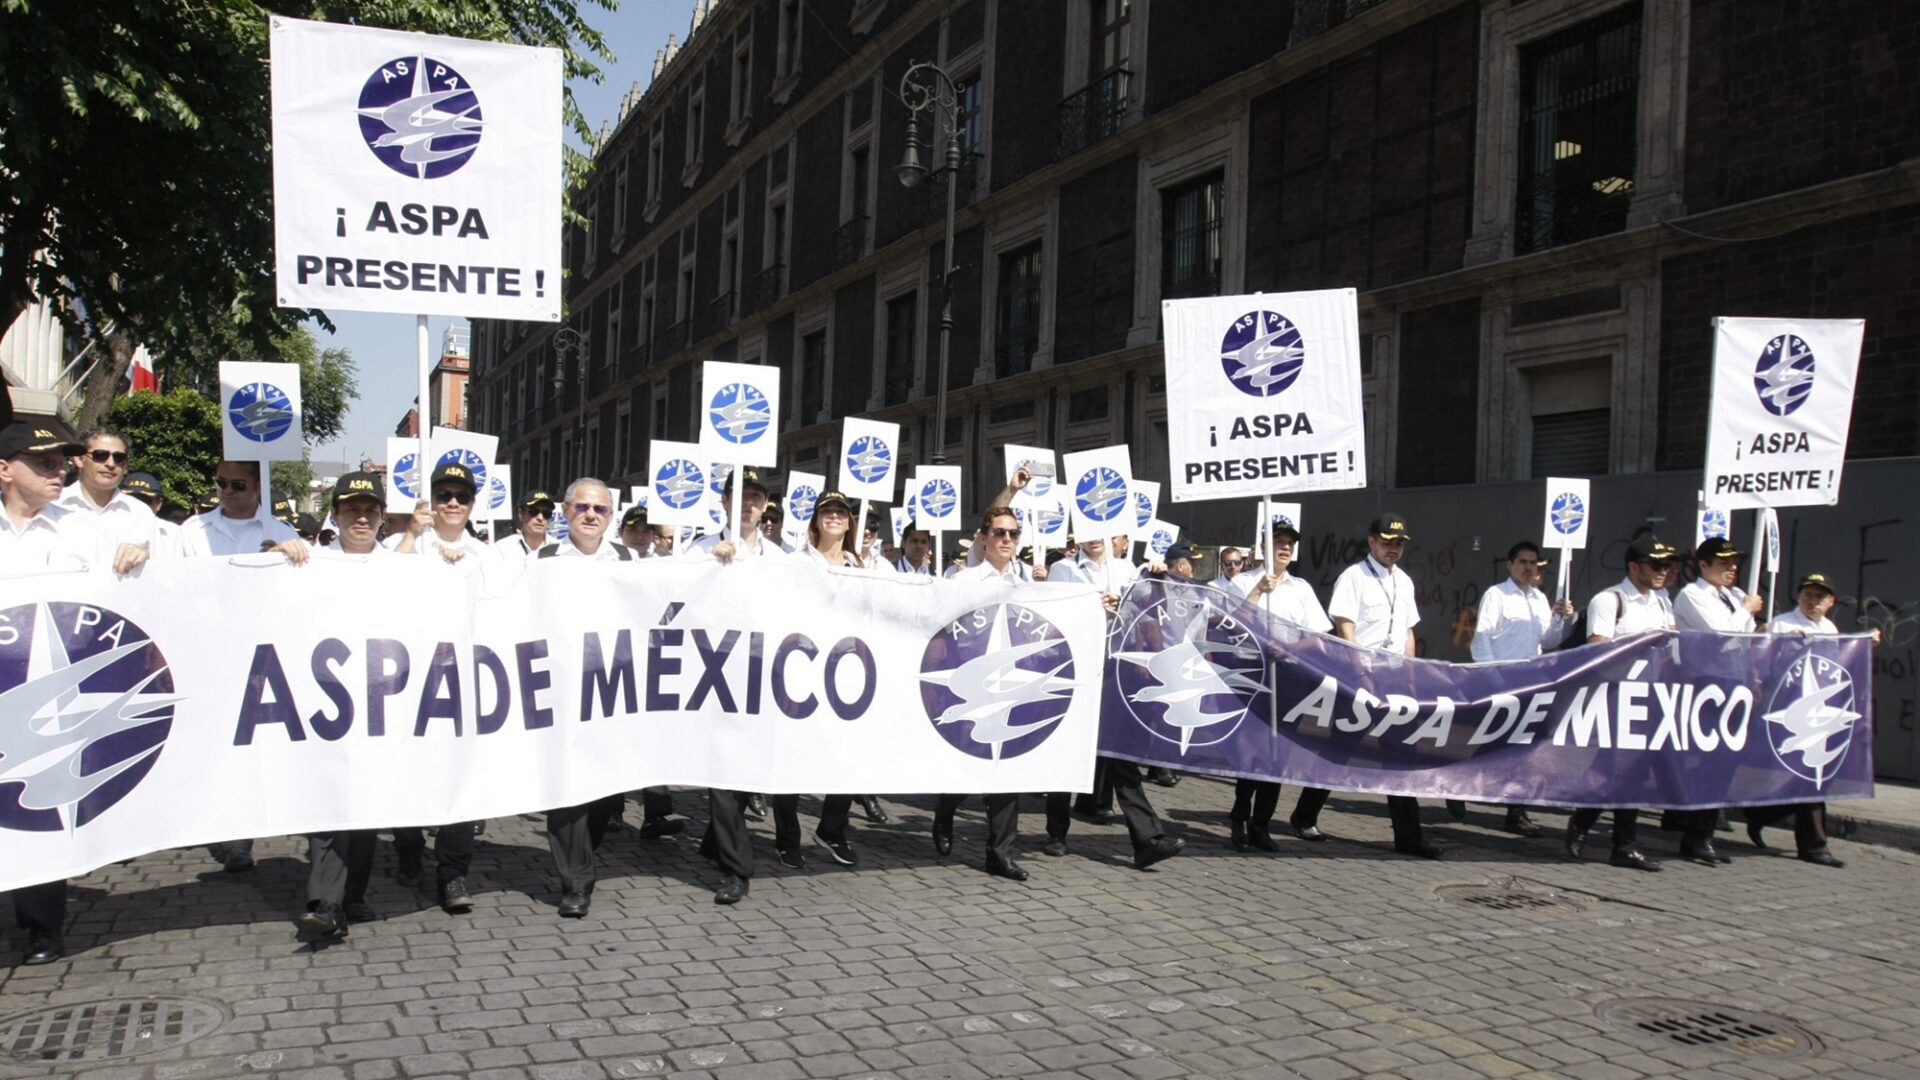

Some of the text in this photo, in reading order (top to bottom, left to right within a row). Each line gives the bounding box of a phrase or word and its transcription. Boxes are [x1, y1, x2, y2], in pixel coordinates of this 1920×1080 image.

[365, 201, 490, 239] ASPA
[297, 255, 521, 297] PRESENTE
[1229, 412, 1314, 440] ASPA
[1750, 432, 1810, 454] ASPA
[445, 467, 466, 478] ASPA
[1185, 452, 1338, 484] PRESENTE
[1715, 470, 1822, 495] PRESENTE
[349, 480, 374, 490] ASPA
[233, 637, 463, 746] ASPA
[580, 601, 878, 722] MÉXICO
[1282, 660, 1753, 753] ASPA DE MÉXICO
